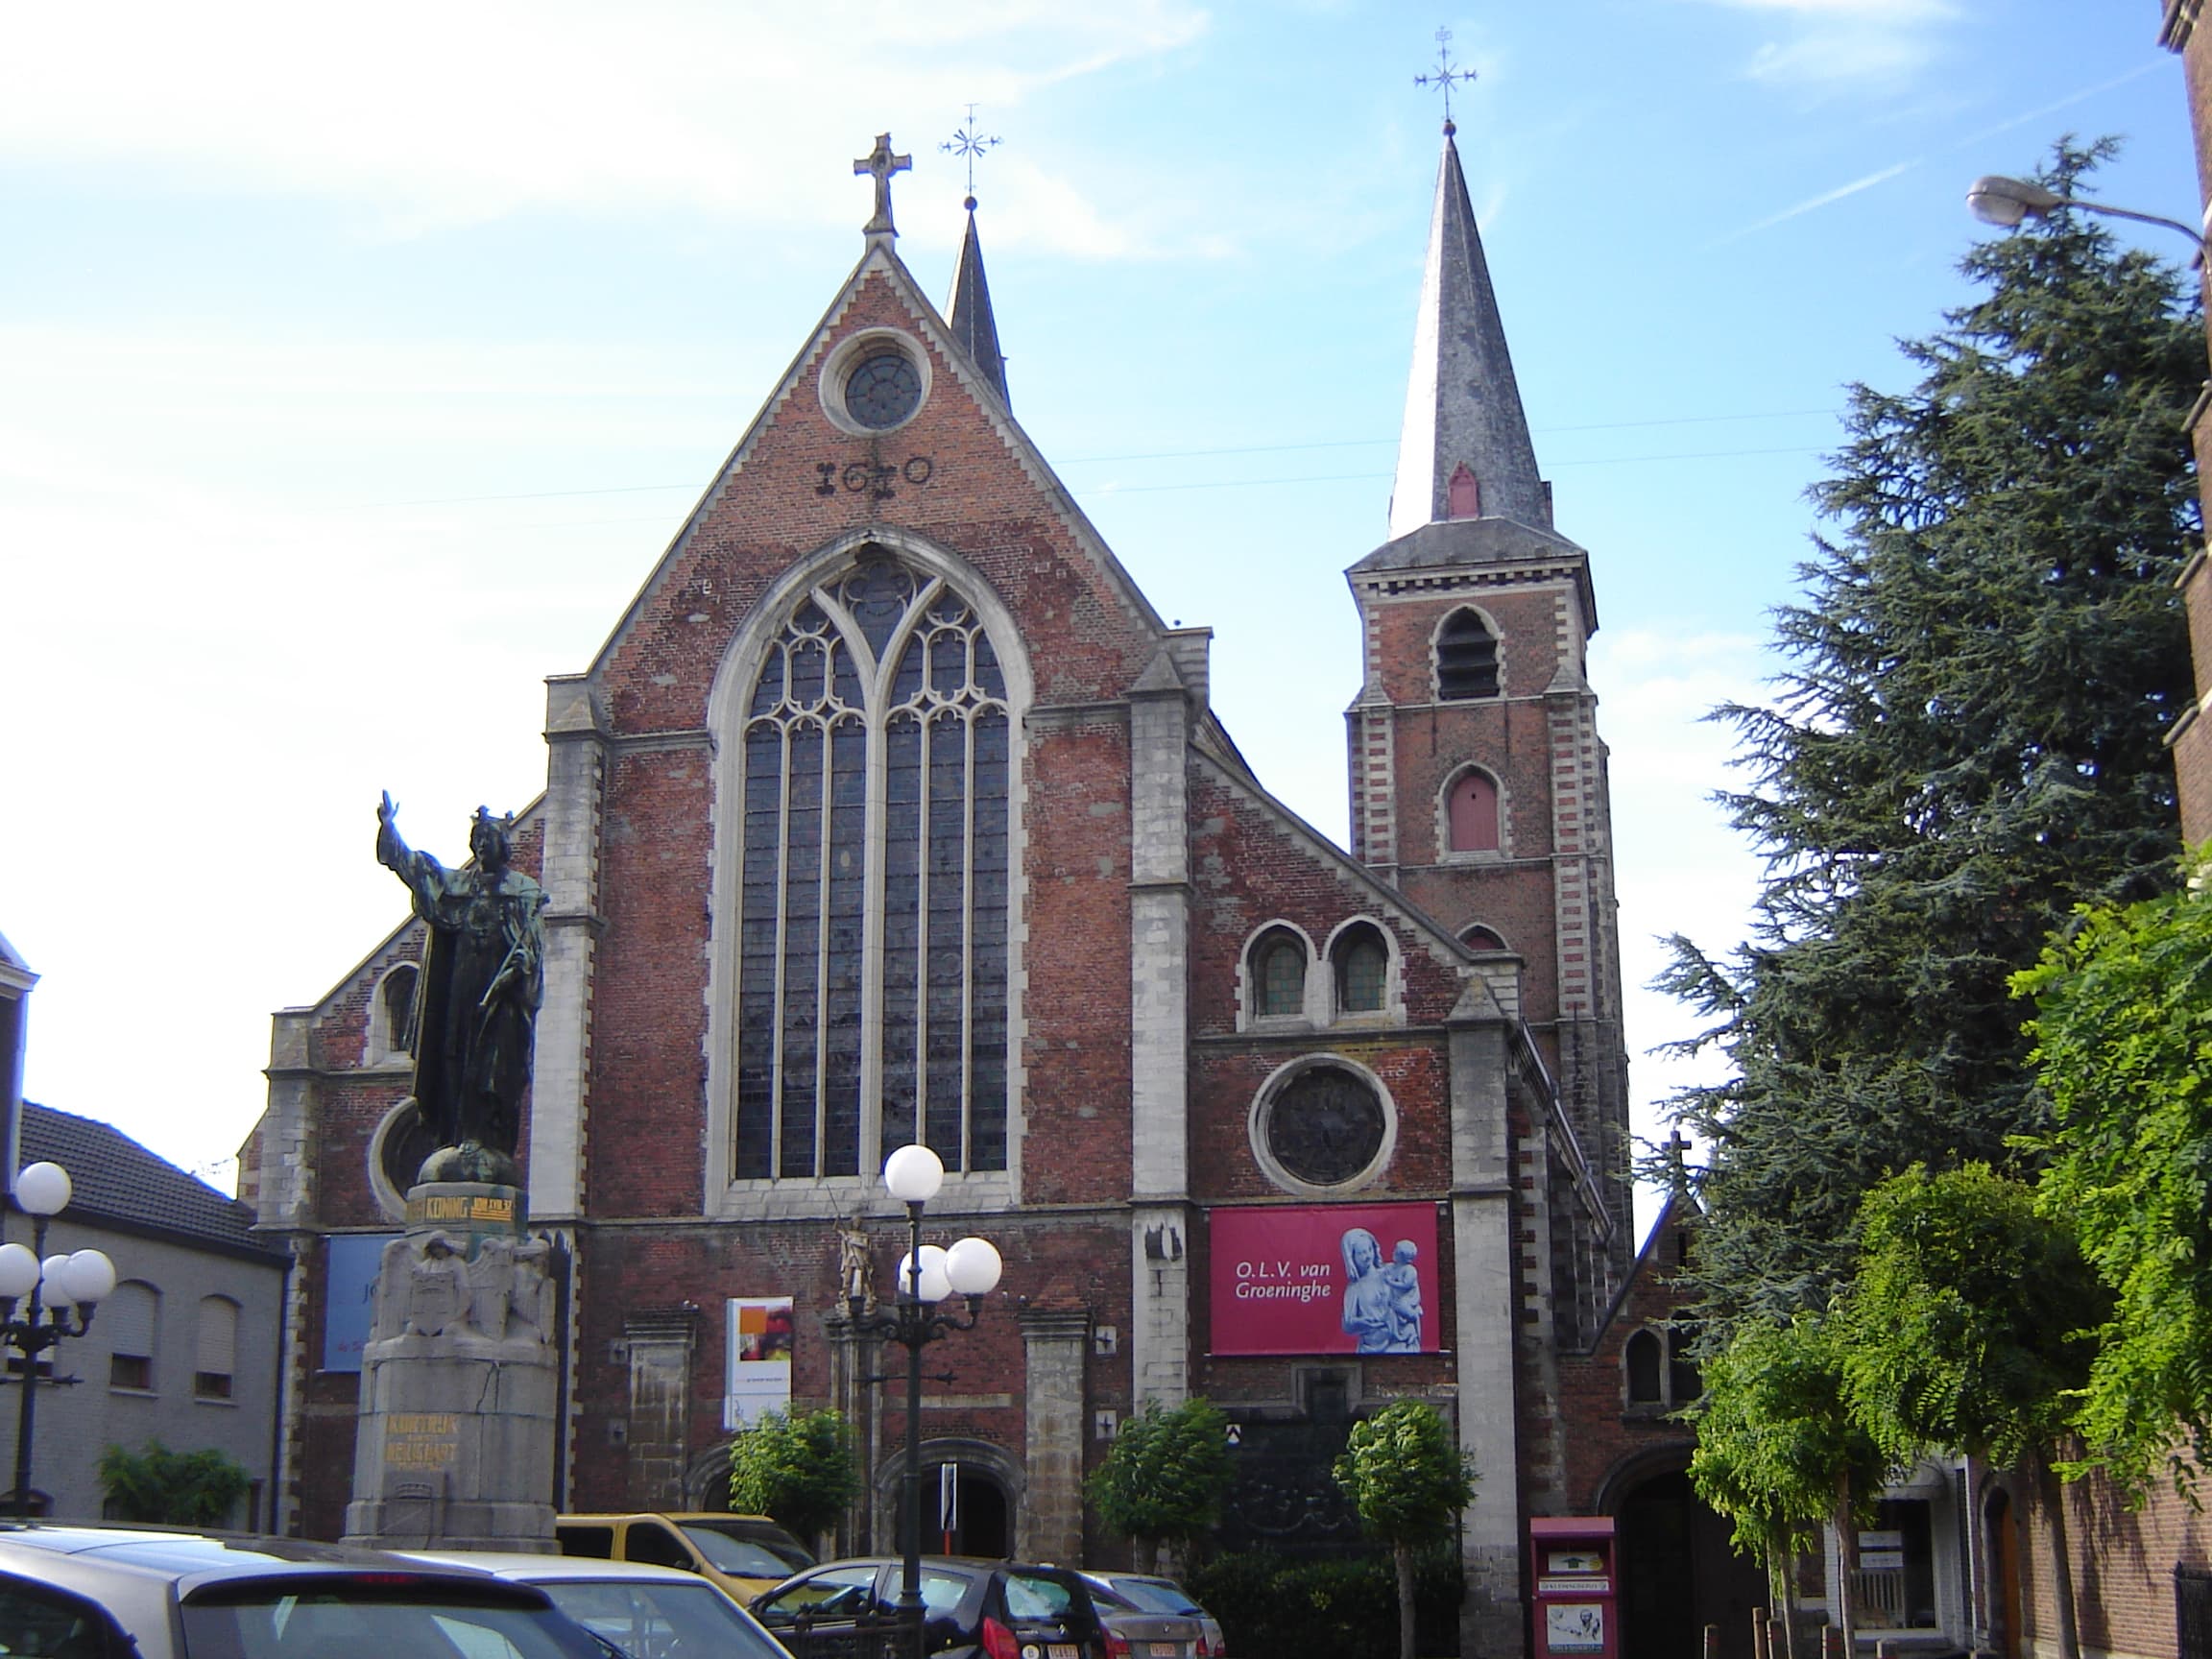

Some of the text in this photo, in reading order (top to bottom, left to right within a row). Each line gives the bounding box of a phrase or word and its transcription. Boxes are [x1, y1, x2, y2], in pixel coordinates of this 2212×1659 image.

[1236, 1261, 1330, 1278] O.L.V. van
[1236, 1280, 1331, 1302] Groeninghe
